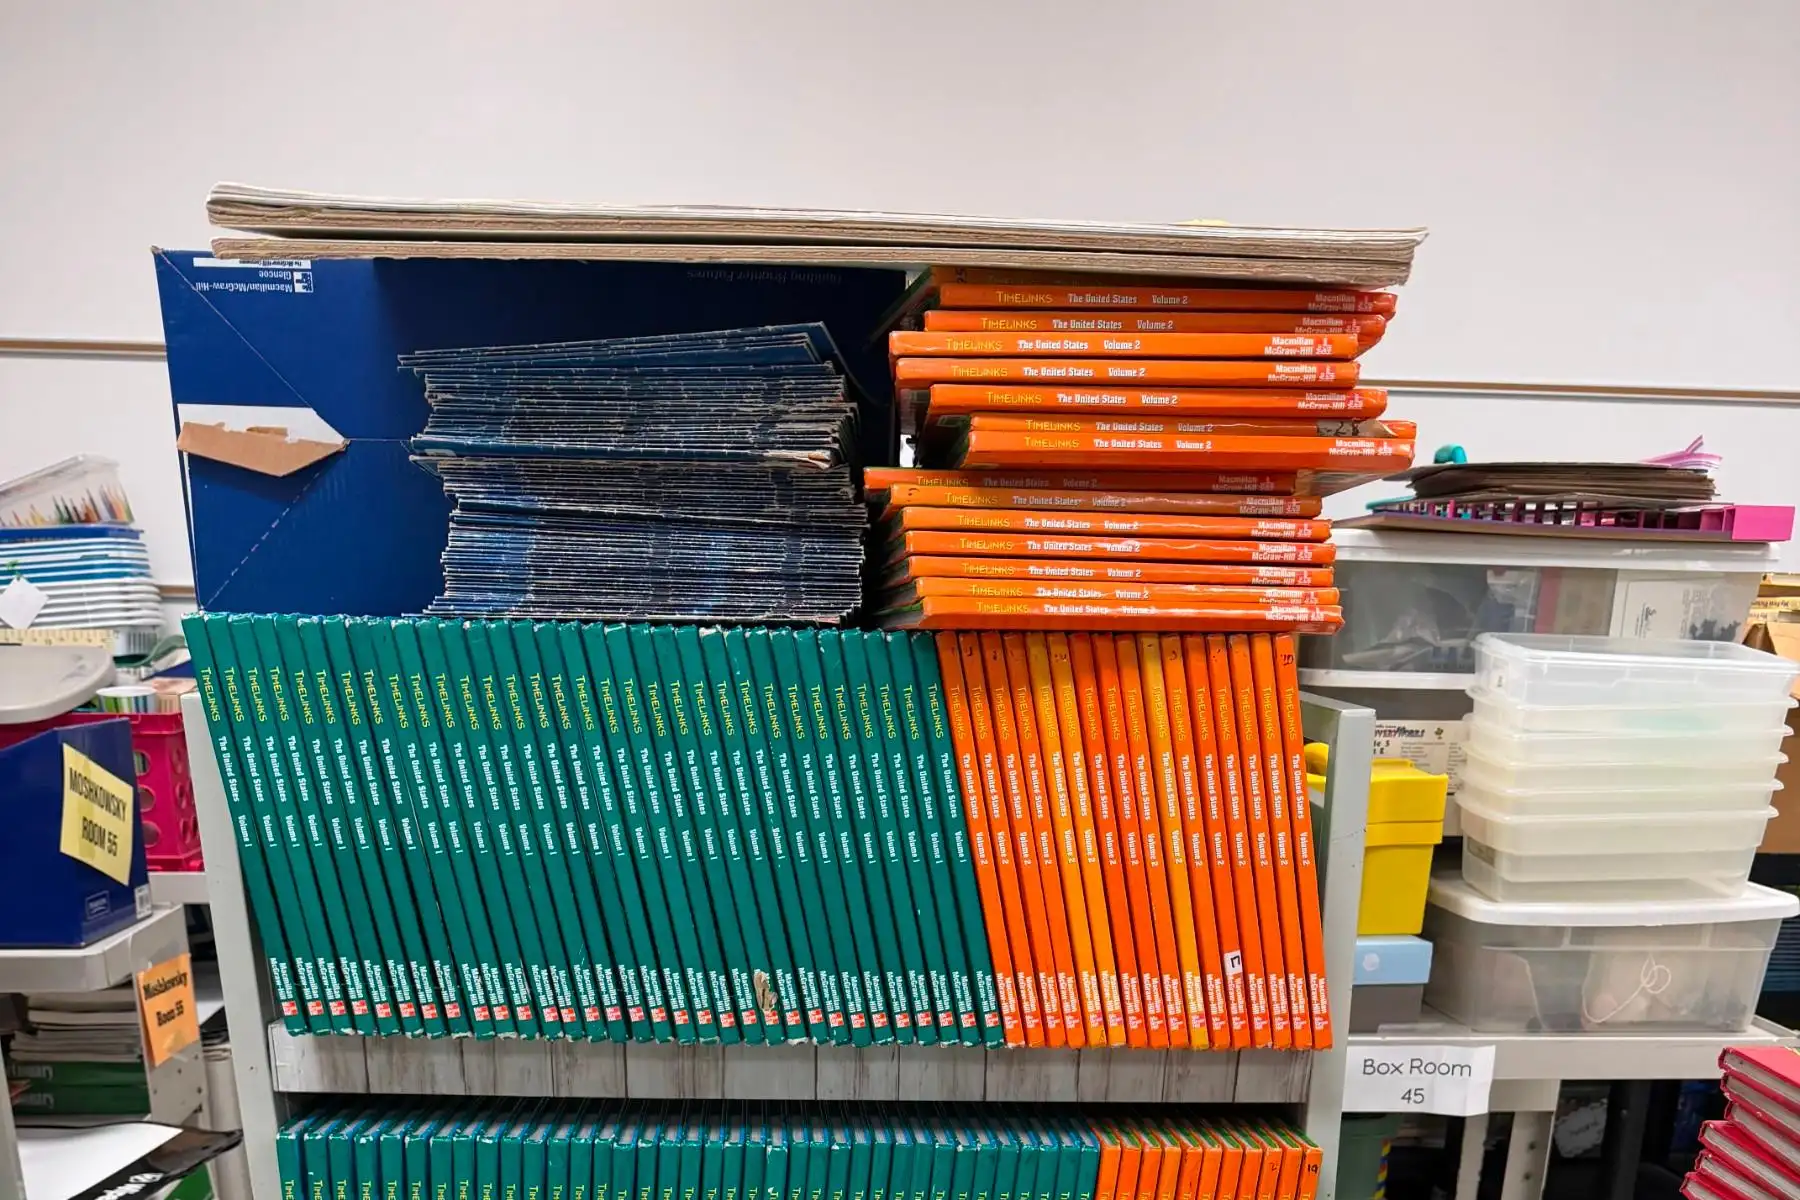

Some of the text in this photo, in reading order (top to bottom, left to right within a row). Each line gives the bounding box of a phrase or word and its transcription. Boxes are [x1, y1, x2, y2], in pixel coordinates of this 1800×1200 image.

[258, 270, 292, 280] Glencoe
[195, 281, 293, 293] Macmillan/McGraw-Hill
[1052, 319, 1068, 329] The
[1070, 319, 1095, 329] United
[1097, 320, 1122, 330] States
[1137, 320, 1166, 330] Volume
[1168, 320, 1174, 330] 2
[1302, 318, 1343, 326] Macmillan
[1018, 340, 1034, 350] The
[1036, 340, 1062, 350] United
[1064, 340, 1088, 350] States
[1104, 340, 1132, 350] Volume
[1134, 340, 1140, 350] 2
[1272, 336, 1314, 346] Macmillan
[1264, 346, 1313, 356] McGraw-Hill
[1024, 367, 1038, 376] The
[1040, 367, 1066, 376] United
[1068, 367, 1094, 377] States
[1108, 368, 1136, 378] Volume
[1138, 368, 1146, 377] 2
[1276, 365, 1316, 373] Macmillan
[1268, 374, 1316, 382] McGraw-Hill
[1057, 394, 1072, 404] The
[1074, 394, 1100, 404] United
[1101, 394, 1126, 404] States
[1142, 394, 1170, 404] Volume
[1172, 394, 1178, 404] 2
[1306, 392, 1346, 400] Macmillan
[1298, 402, 1345, 410] McGraw-Hill
[1096, 422, 1111, 431] The
[1112, 422, 1138, 432] United
[1139, 422, 1164, 432] States
[1178, 423, 1204, 432] Volume
[1207, 423, 1213, 432] 2
[1094, 438, 1110, 448] The
[1111, 438, 1136, 448] United
[1138, 440, 1162, 448] States
[1176, 440, 1203, 449] Volume
[1205, 440, 1212, 449] 2
[1336, 439, 1374, 448] Macmillan
[1329, 448, 1375, 456] McGraw-Hill
[1025, 518, 1040, 528] The
[1042, 518, 1064, 529] United
[1066, 518, 1091, 529] States
[1104, 520, 1132, 530] Volume
[1134, 520, 1140, 529] 2
[1258, 521, 1296, 529] Macmillan
[1251, 530, 1295, 538] McGraw-Hill
[1028, 566, 1044, 576] The
[201, 666, 220, 722] TIMELINKS
[506, 674, 526, 730] TIMELINKS
[218, 736, 227, 751] The
[524, 744, 532, 760] The
[222, 753, 235, 778] United
[527, 760, 540, 785] United
[228, 778, 240, 802] States
[534, 786, 544, 810] States
[238, 814, 249, 842] Volume
[82, 816, 118, 857] ROOM 55
[543, 823, 554, 850] Volume
[1362, 1058, 1472, 1077] Box Room
[1400, 1088, 1425, 1104] 45
